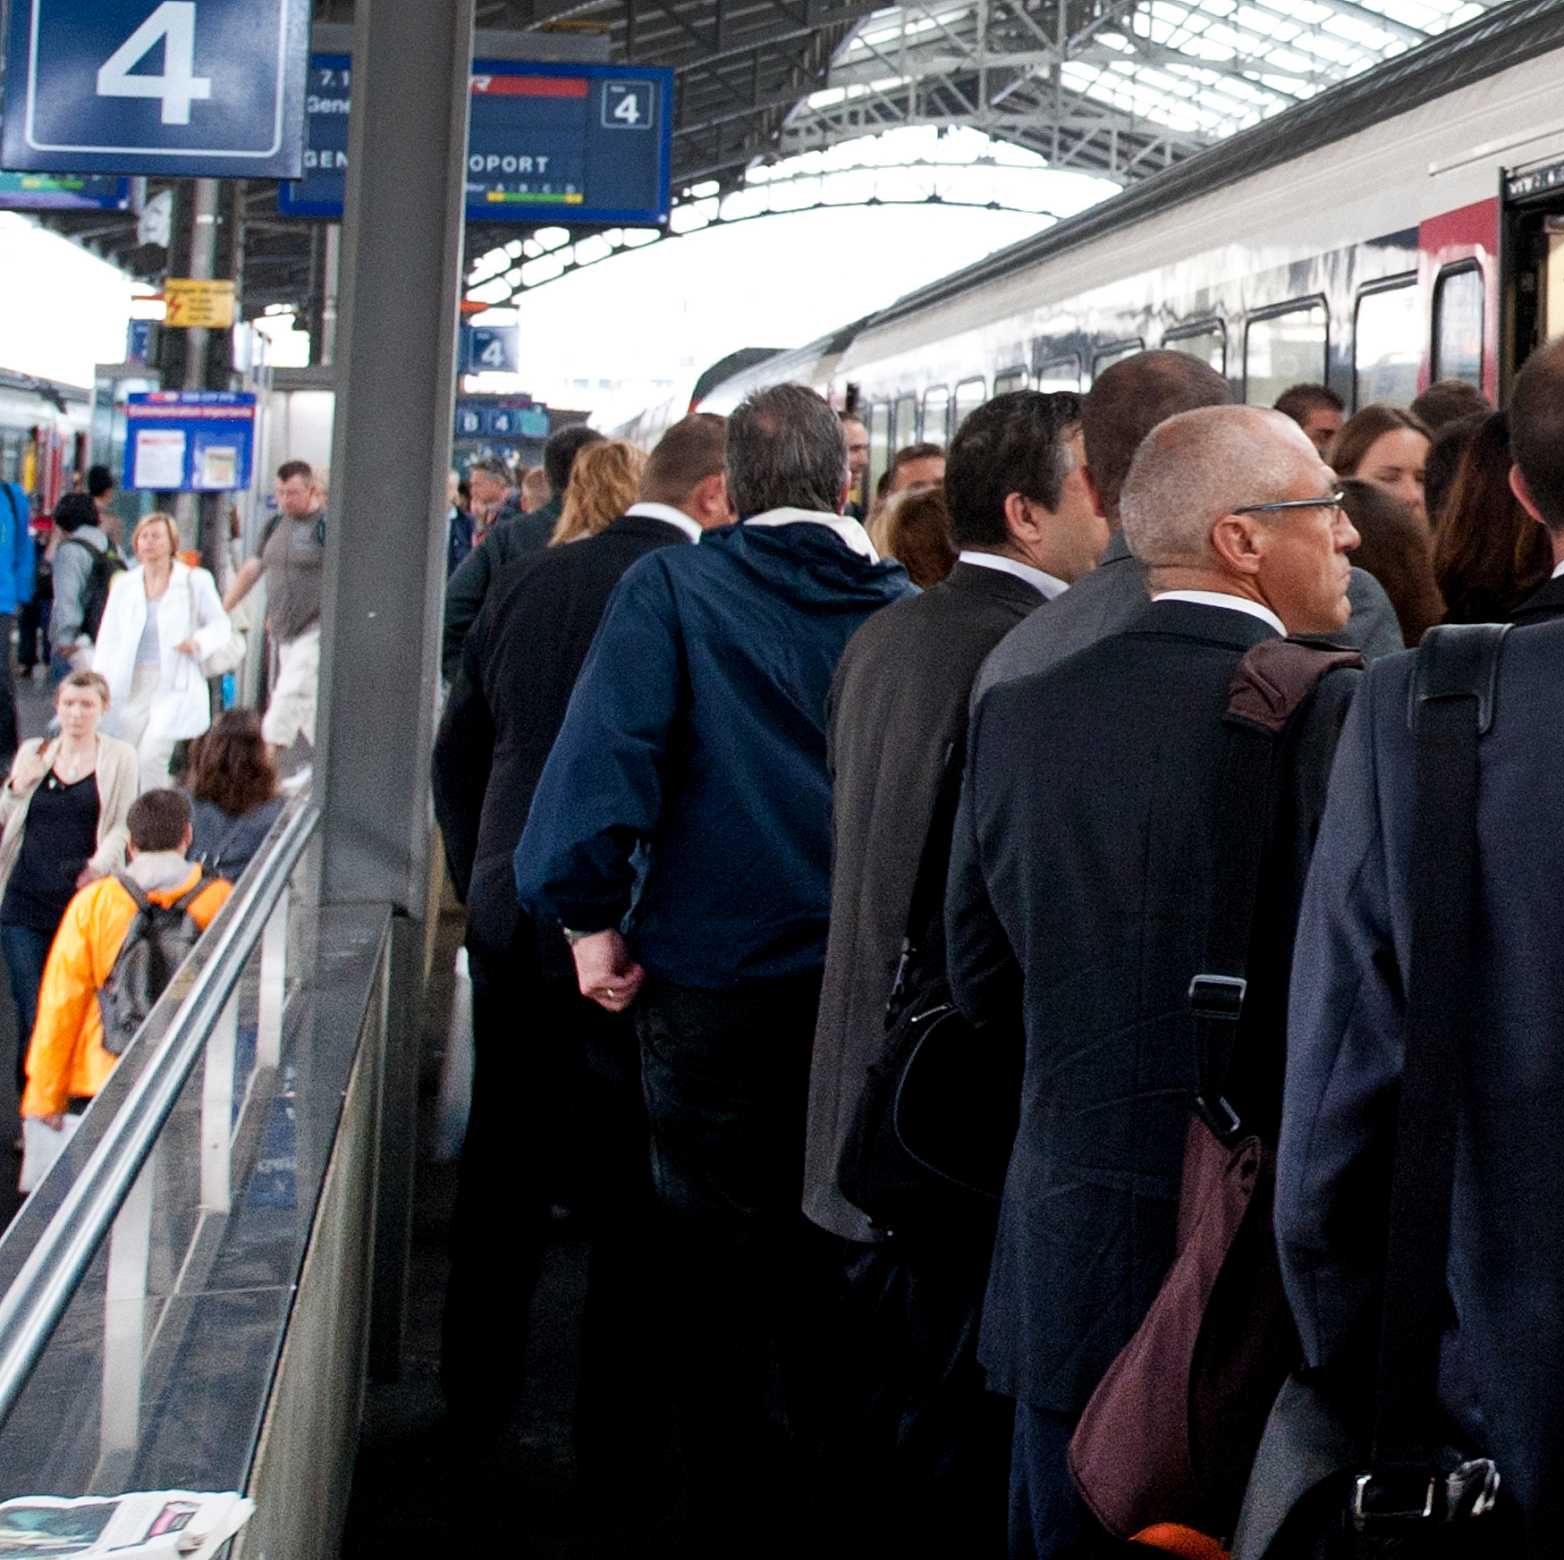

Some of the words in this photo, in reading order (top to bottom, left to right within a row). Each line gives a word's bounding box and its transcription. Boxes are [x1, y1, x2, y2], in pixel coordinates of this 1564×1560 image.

[96, 1, 211, 125] 4
[320, 69, 350, 87] 7.1
[613, 93, 640, 124] 4
[303, 150, 348, 169] GEN
[469, 154, 549, 174] OPORT
[481, 338, 505, 367] 4
